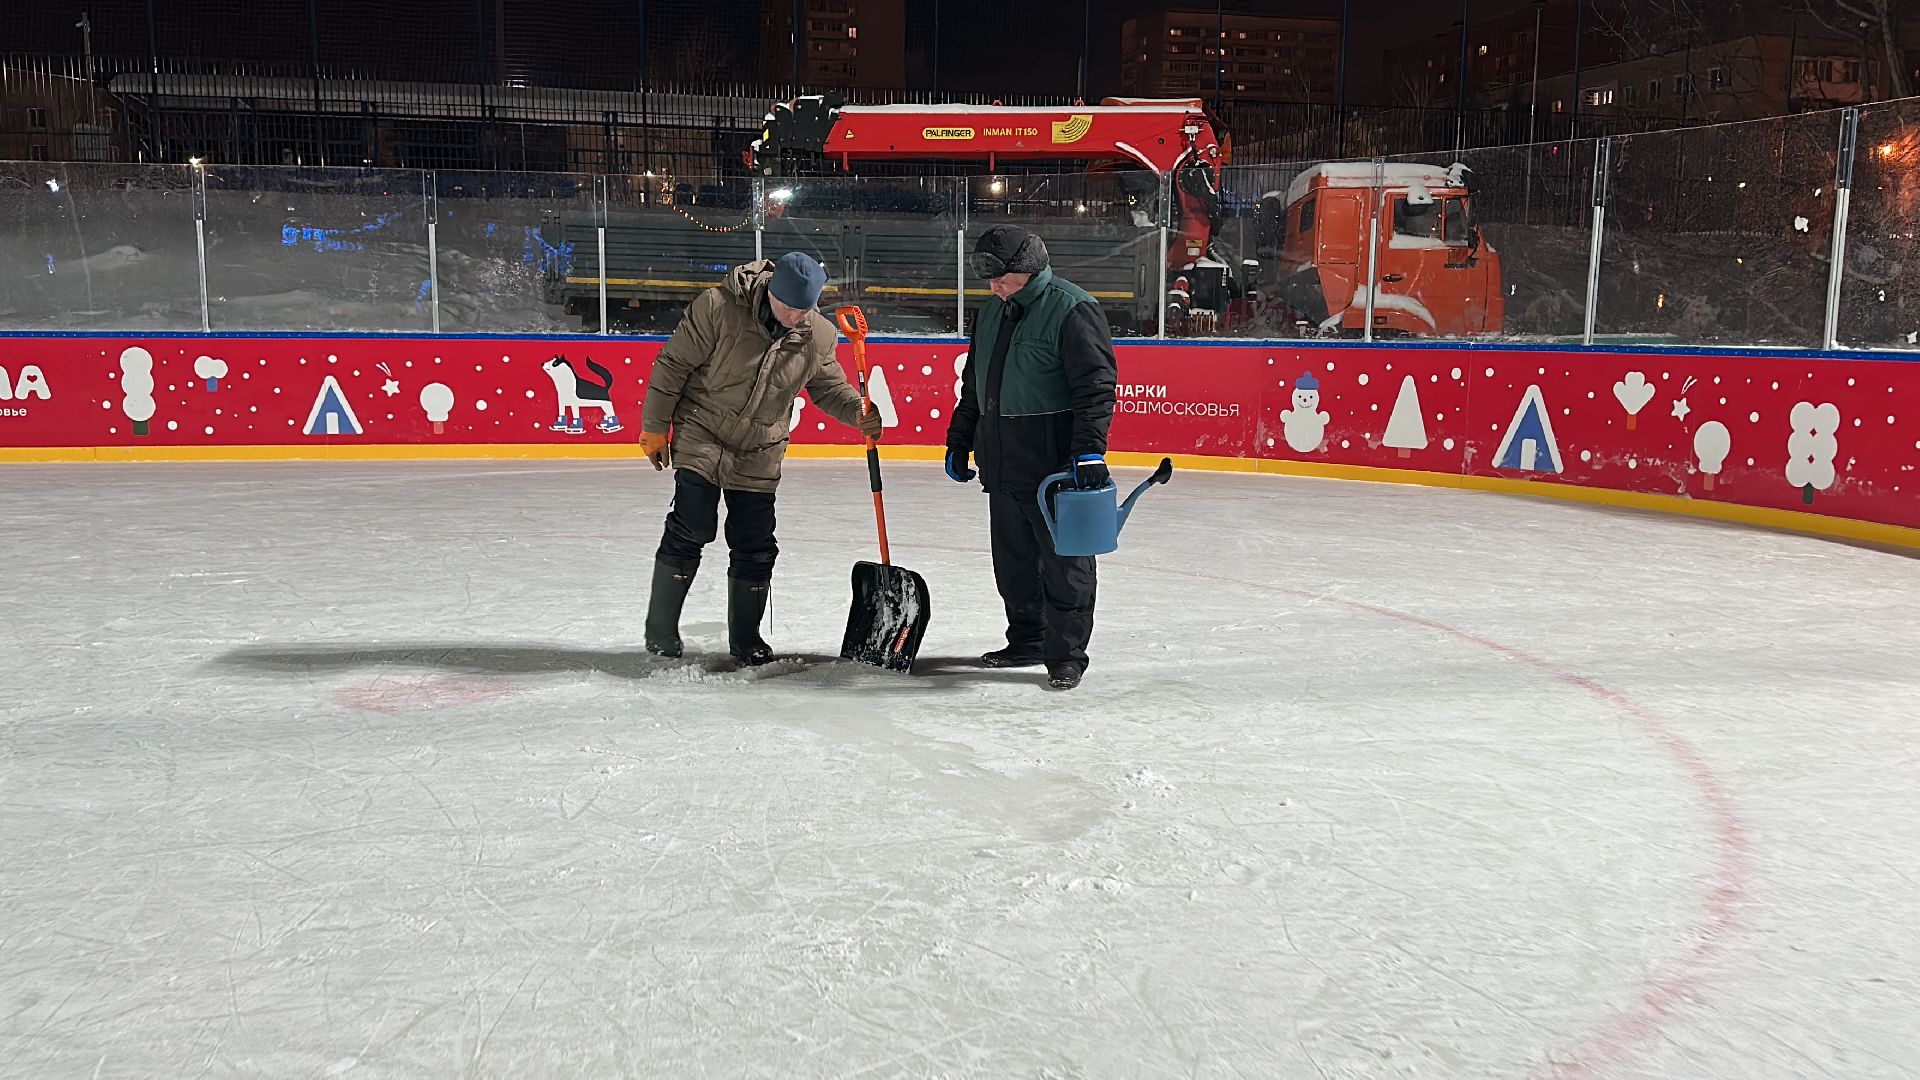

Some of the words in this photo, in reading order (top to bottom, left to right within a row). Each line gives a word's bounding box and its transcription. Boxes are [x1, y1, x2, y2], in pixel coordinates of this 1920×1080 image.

[925, 129, 972, 137] PALFINGER
[983, 128, 1012, 136] INMAN
[1115, 384, 1167, 398] ПАРКИ
[1113, 400, 1240, 417] ПОДМОСКОВЬЯ
